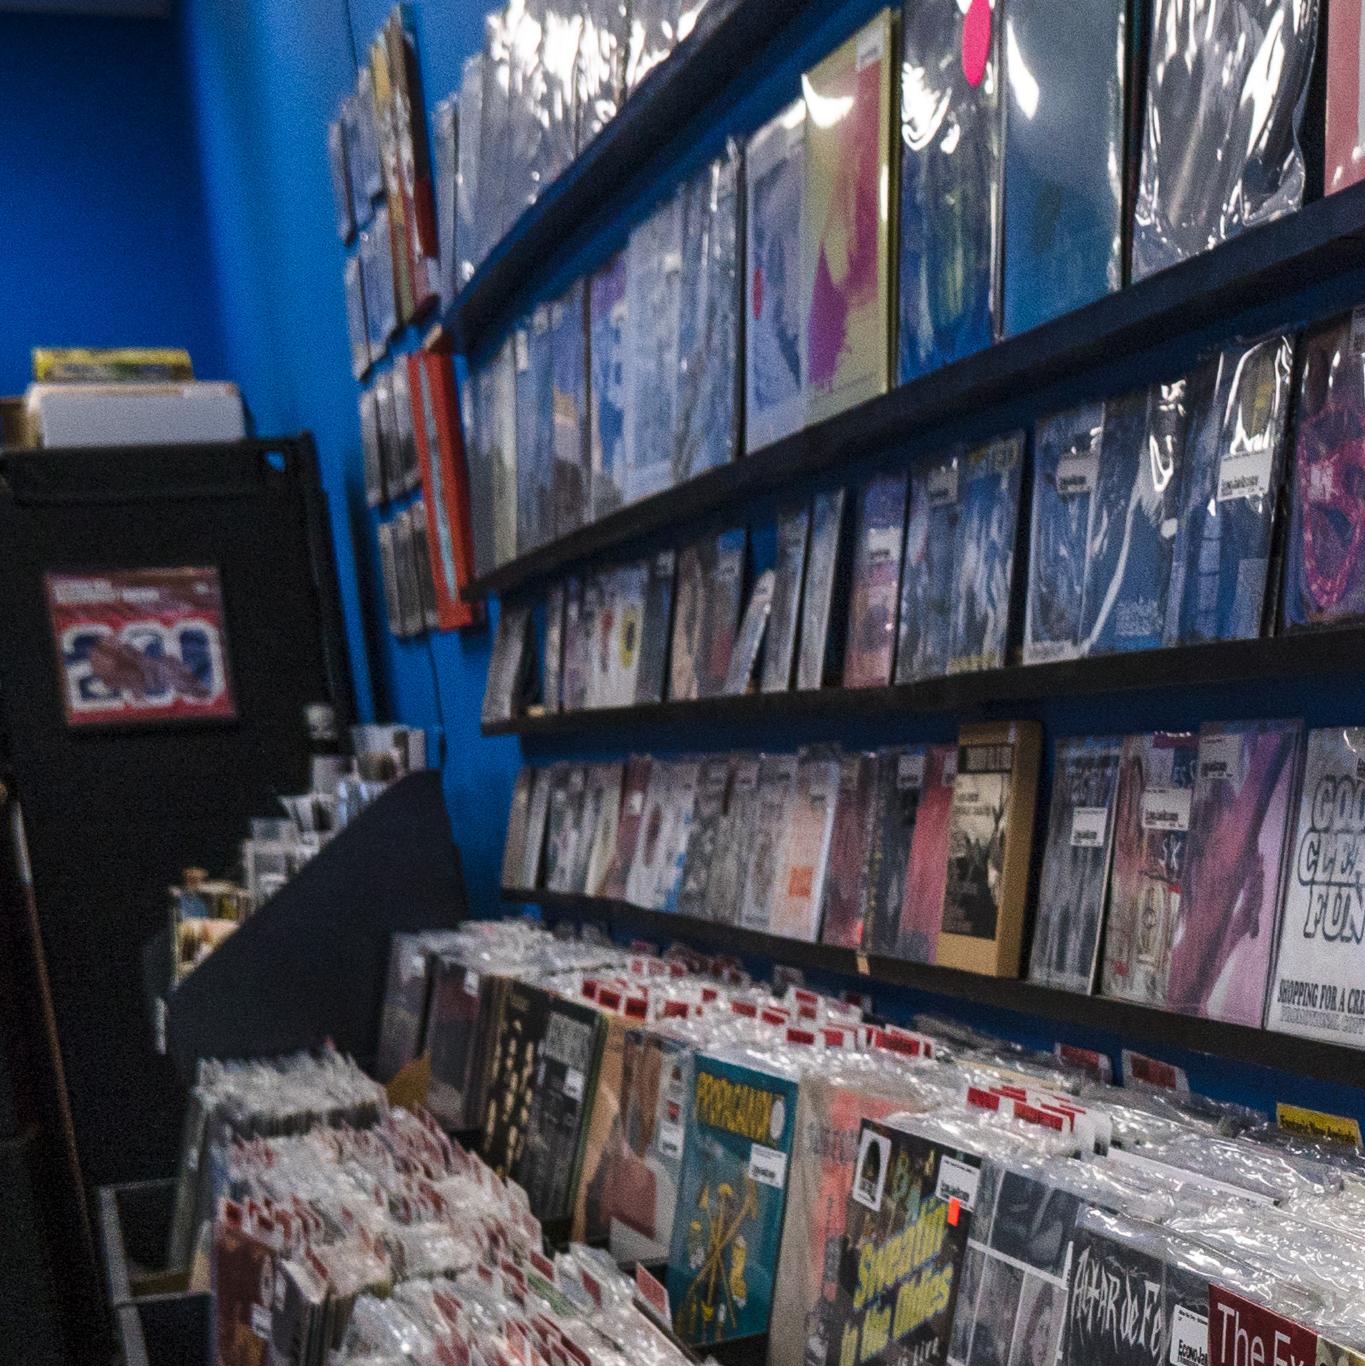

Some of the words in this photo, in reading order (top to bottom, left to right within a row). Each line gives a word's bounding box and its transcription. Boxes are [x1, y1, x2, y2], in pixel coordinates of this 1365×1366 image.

[1279, 979, 1320, 1008] SHOPPING
[1321, 984, 1337, 1011] FOR
[1338, 987, 1345, 1012] A
